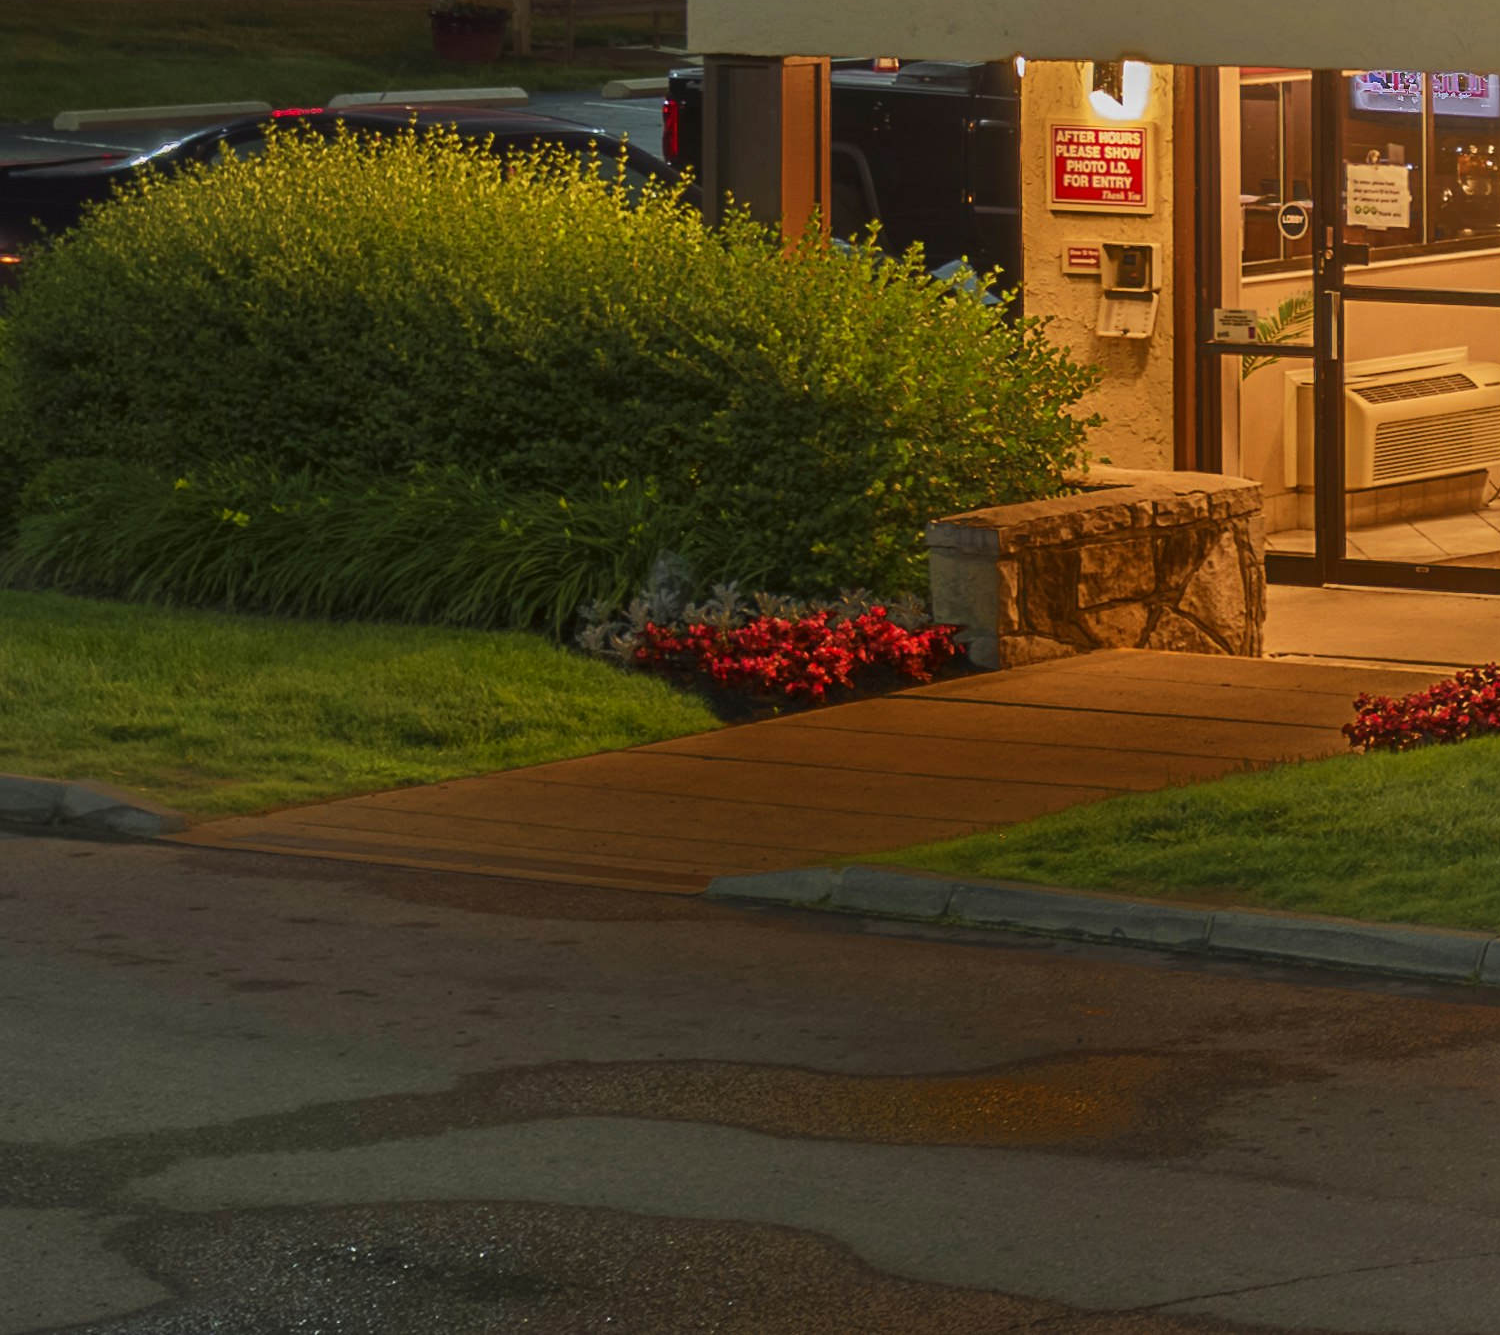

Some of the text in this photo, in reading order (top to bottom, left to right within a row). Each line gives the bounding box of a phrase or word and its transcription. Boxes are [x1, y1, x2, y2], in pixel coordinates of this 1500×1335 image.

[1056, 130, 1141, 145] AFTER HOURS
[1055, 145, 1141, 159] PLEASE SHOW
[1066, 160, 1131, 174] PHOTO I.D.
[1063, 174, 1133, 189] FOR ENTRY
